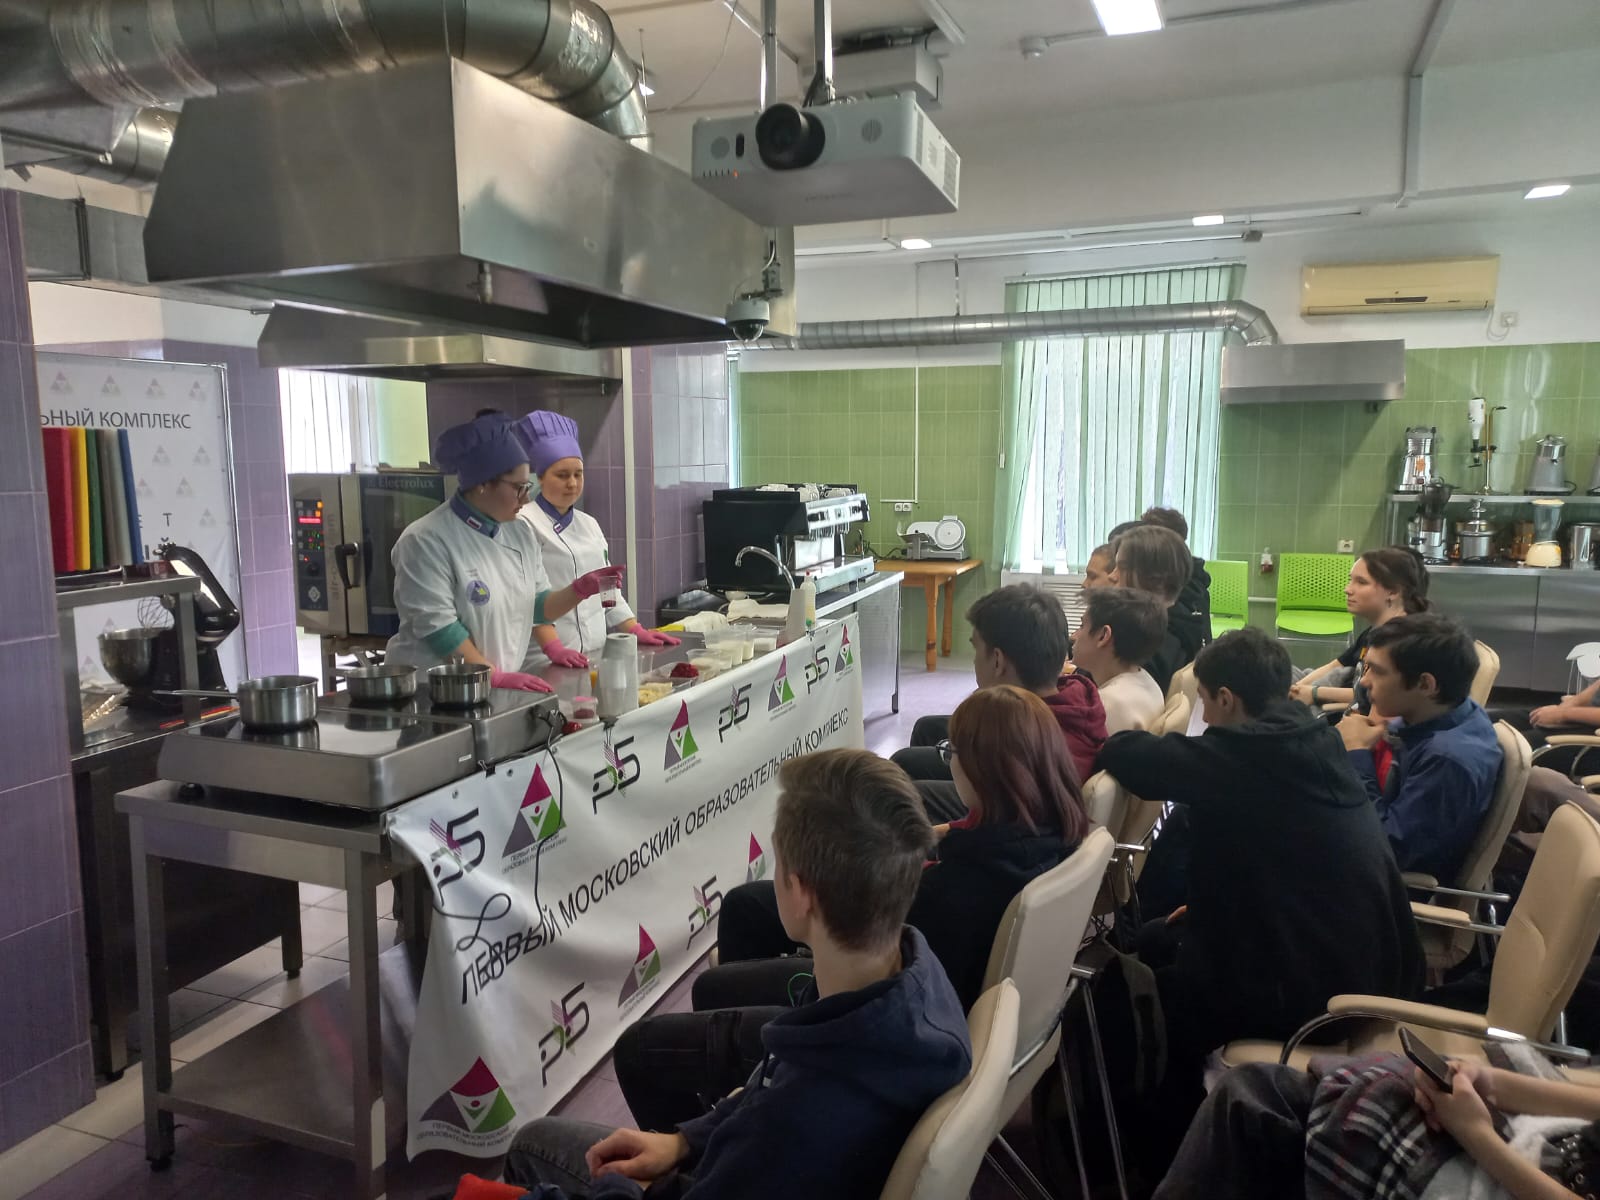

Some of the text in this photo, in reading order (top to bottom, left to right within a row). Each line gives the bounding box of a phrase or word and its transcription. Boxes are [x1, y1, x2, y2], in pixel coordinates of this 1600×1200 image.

[100, 411, 191, 429] КОМПЛЕКС
[379, 476, 434, 489] Electrolux
[558, 815, 681, 928] МОСКОВСКИЙ
[684, 736, 803, 835] ОБРАЗОВАТЕЛЬНЫЙ
